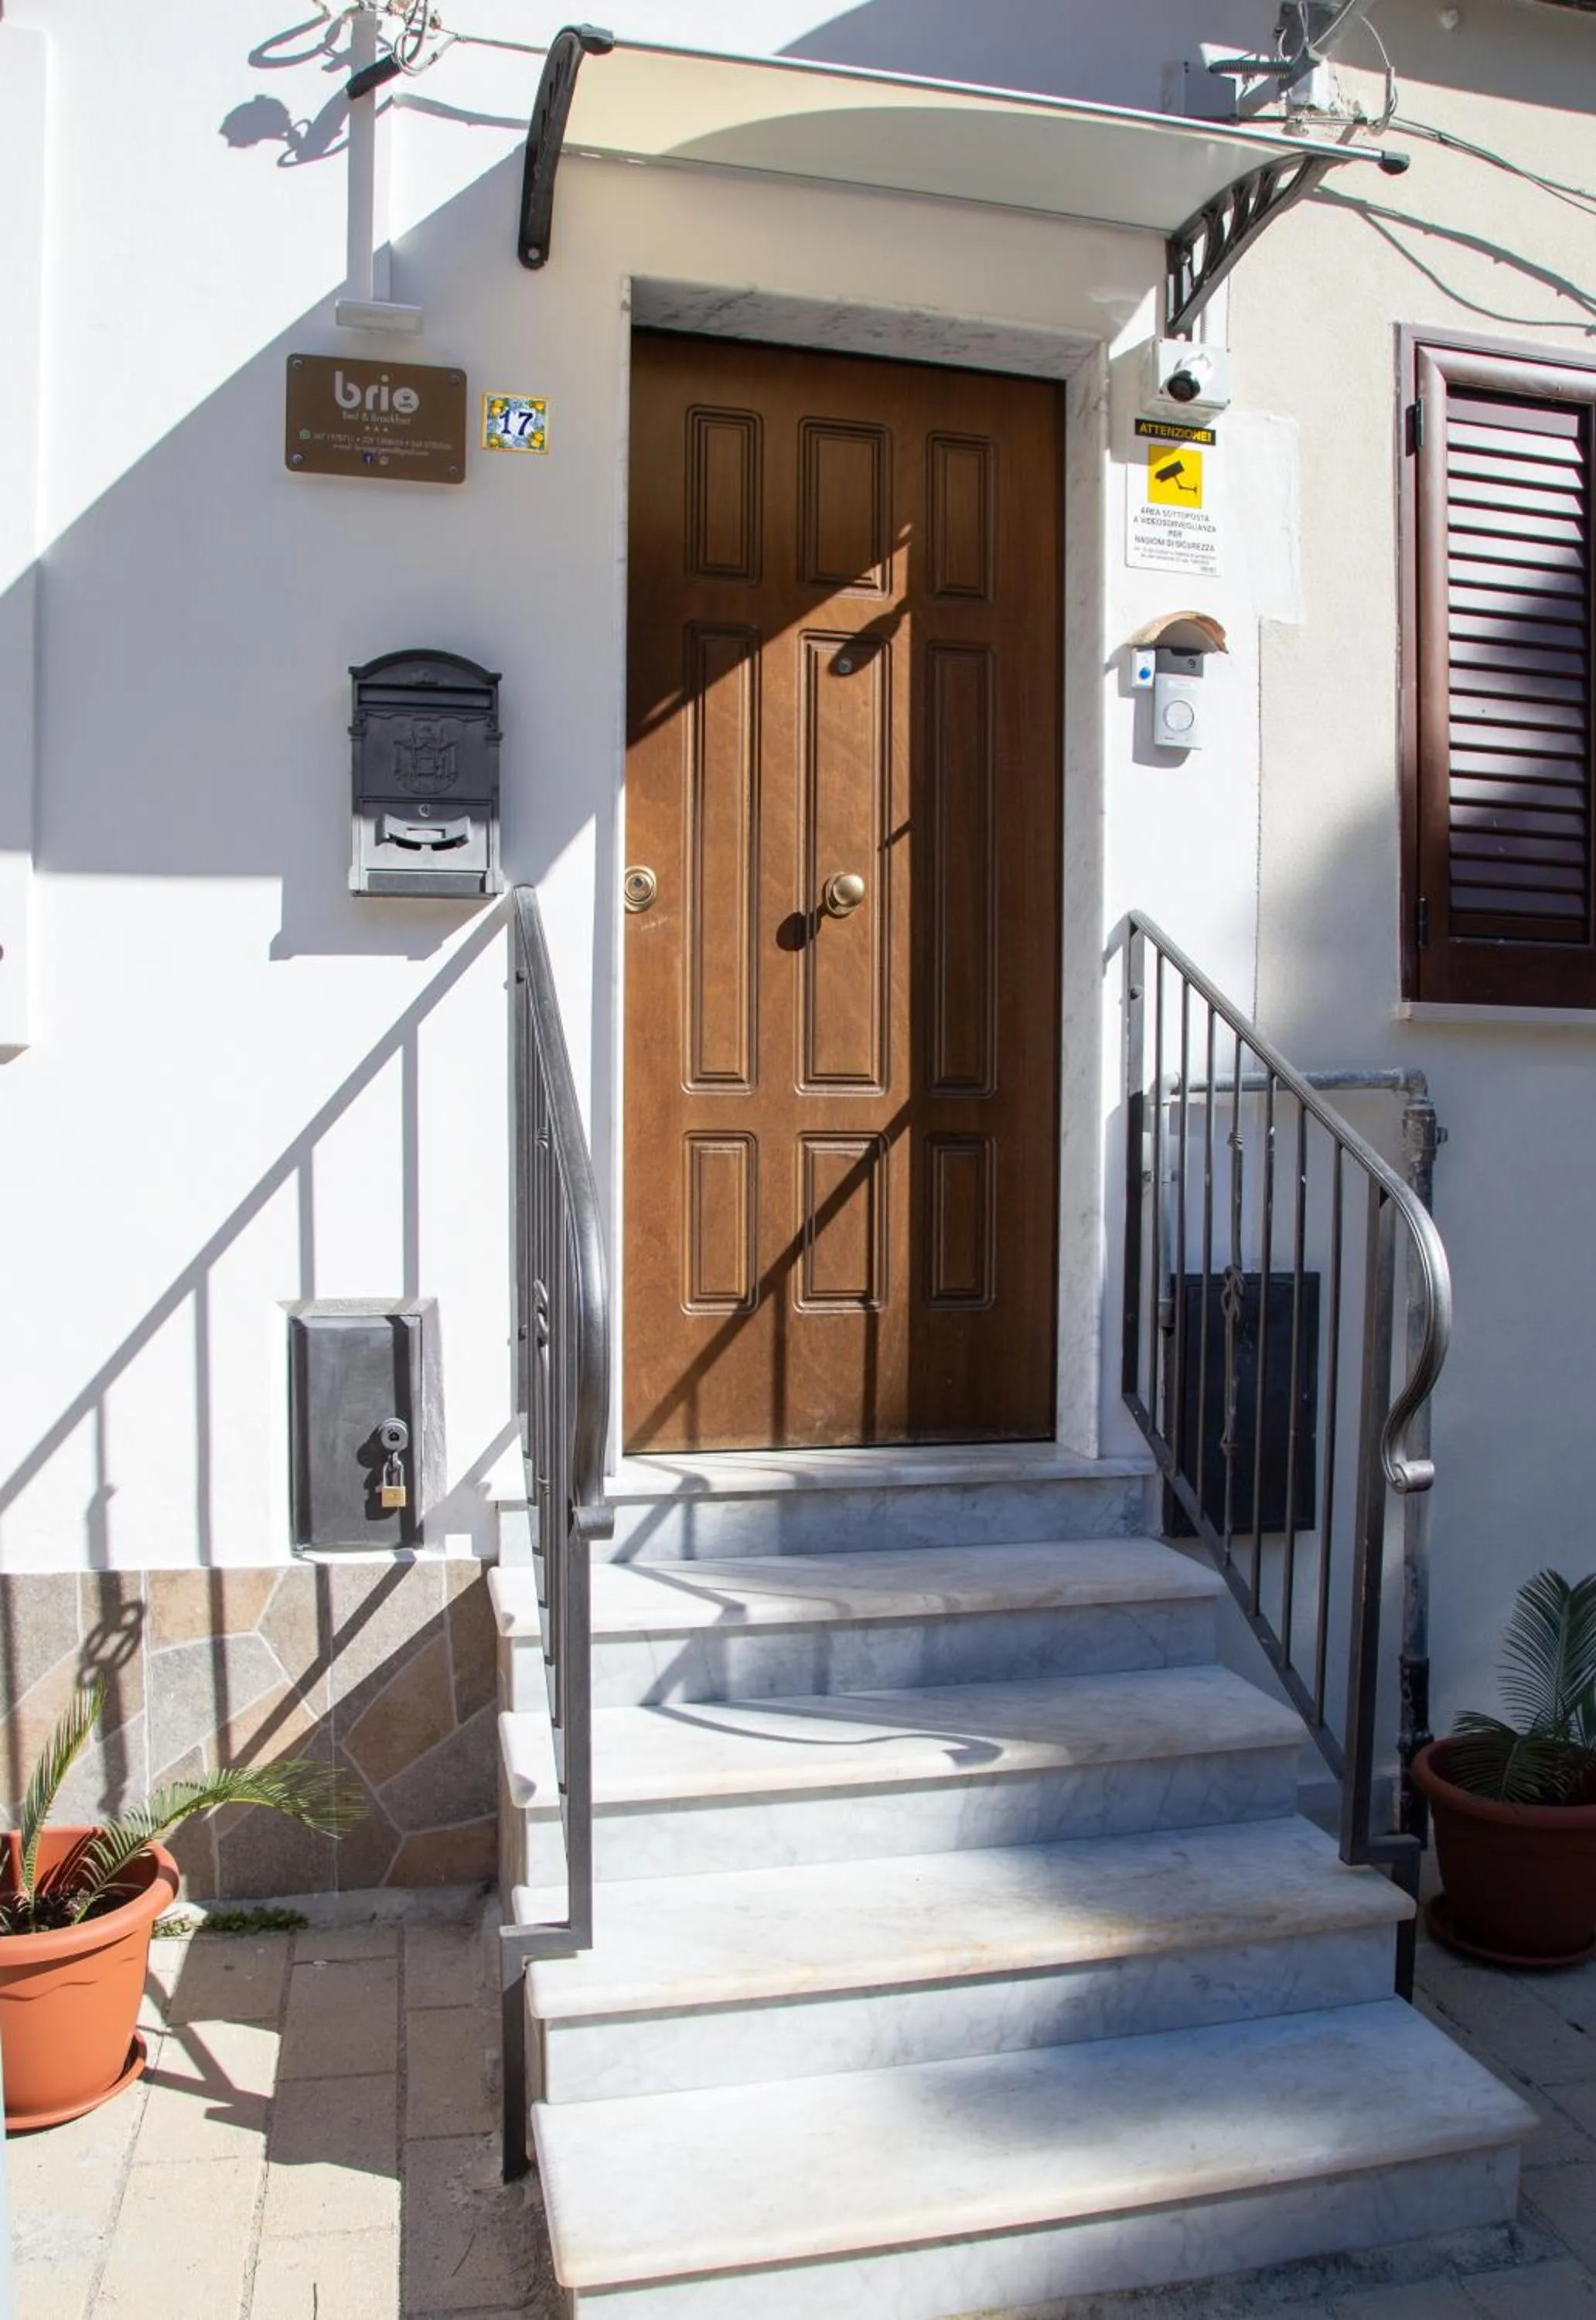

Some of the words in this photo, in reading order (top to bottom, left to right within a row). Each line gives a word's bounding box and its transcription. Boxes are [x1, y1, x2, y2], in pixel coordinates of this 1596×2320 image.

[499, 410, 534, 436] 17
[1139, 422, 1212, 442] ATTENZIONE!
[1141, 507, 1161, 517] AREA
[1163, 509, 1210, 522] SOTTOPOSTA
[1175, 540, 1216, 551] SICUREZZA
